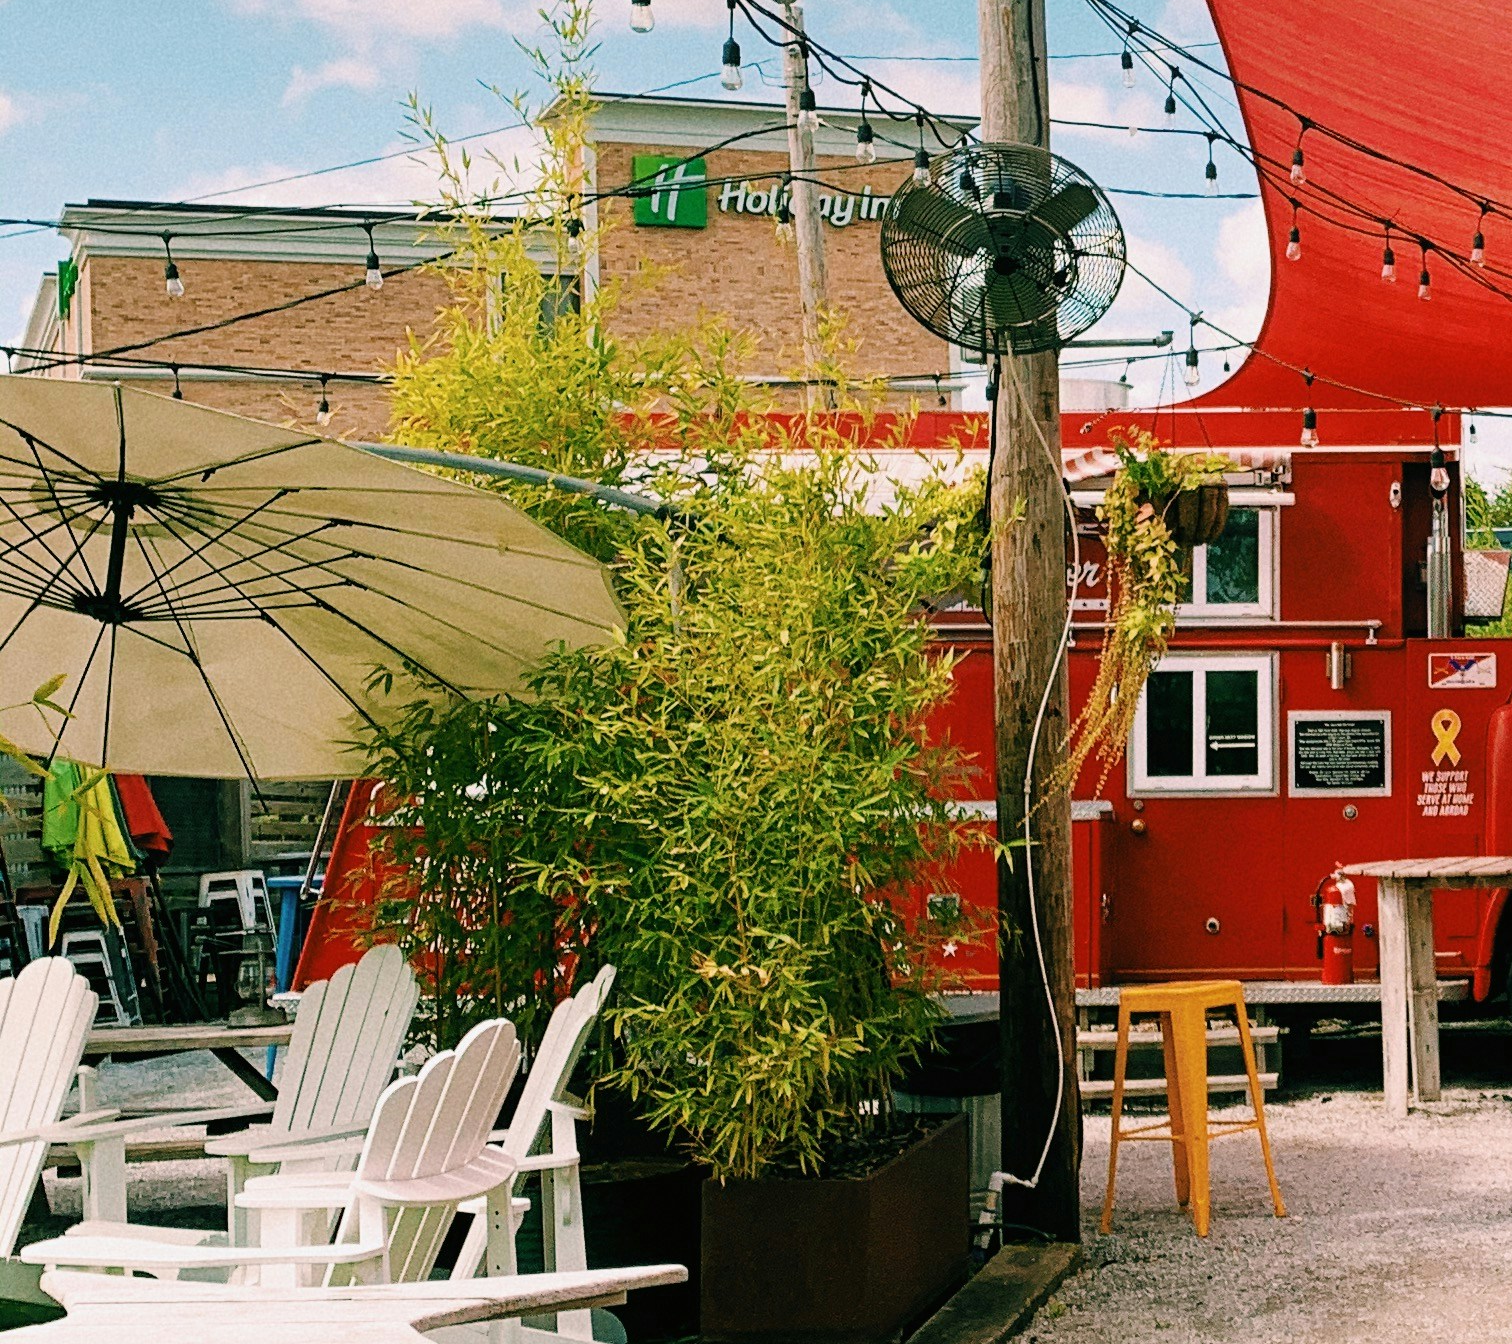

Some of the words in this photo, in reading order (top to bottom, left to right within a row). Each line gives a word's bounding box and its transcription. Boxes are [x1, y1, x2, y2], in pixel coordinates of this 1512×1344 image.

[1421, 770, 1435, 783] WE
[1435, 770, 1469, 783] SUPPORT
[1424, 782, 1448, 794] THOSE
[1448, 782, 1467, 794] WHO
[1416, 794, 1441, 806] SERVE
[1440, 794, 1452, 805] AT
[1452, 793, 1475, 805] HOME
[1421, 805, 1439, 817] AND
[1438, 804, 1470, 817] ABROAD
